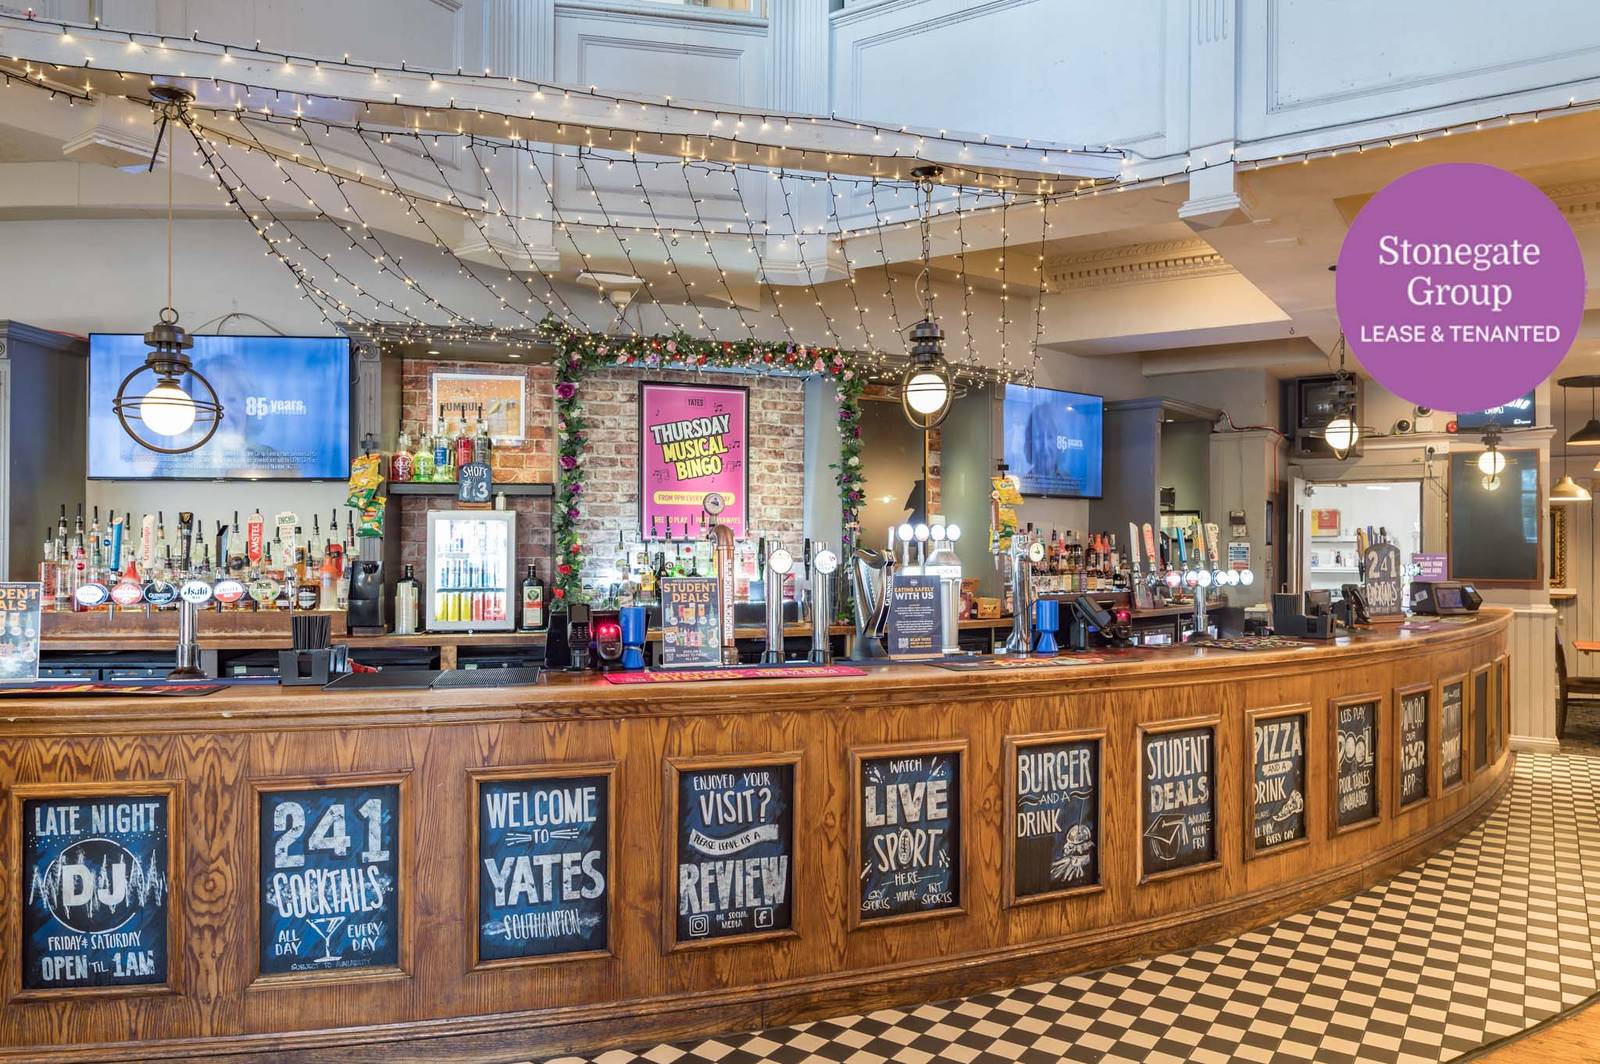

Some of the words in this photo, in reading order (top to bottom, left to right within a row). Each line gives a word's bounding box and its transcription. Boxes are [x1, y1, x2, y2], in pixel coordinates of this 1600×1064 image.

[650, 413, 730, 445] THURSDAY
[662, 433, 729, 463] MUSICAL
[463, 465, 488, 478] SHOTS
[674, 455, 723, 480] BINGO
[251, 522, 260, 553] AMSTEL
[0, 588, 39, 600] DENT
[183, 586, 208, 595] Asahi
[663, 583, 717, 593] STUDENT
[672, 592, 710, 602] DEALS
[895, 592, 920, 600] WITH
[921, 592, 934, 600] US
[0, 600, 27, 611] ALS
[1255, 721, 1302, 764] PIZZA
[1338, 727, 1374, 772] POOL
[890, 758, 923, 774] WATCH
[1147, 735, 1210, 780] STUDENT
[693, 774, 735, 791] ENJOYED
[743, 772, 770, 788] YOUR
[1018, 749, 1092, 795] BURGER
[486, 787, 597, 829] WELCOME
[700, 787, 771, 826] VISIT?
[865, 780, 949, 828] LIVE
[1040, 793, 1060, 804] AND
[1061, 791, 1070, 802] A
[1151, 776, 1210, 813] DEALS
[35, 806, 80, 836] LATE
[91, 803, 159, 834] NIGHT
[1017, 808, 1062, 837] DRINK
[534, 829, 550, 843] TO
[693, 834, 716, 850] PLEASE
[719, 841, 739, 850] LEAVE
[754, 831, 761, 840] A
[873, 828, 943, 872] SPORT
[62, 863, 126, 906] DJ
[272, 865, 383, 918] COCKTAILS
[484, 850, 605, 907] YATES
[679, 855, 788, 916] REVIEW
[895, 871, 919, 886] HERE
[921, 891, 952, 905] SPORTS
[279, 929, 300, 942] ALL
[348, 921, 383, 938] EVERY
[503, 909, 581, 940] SOUTHAMPTON
[48, 935, 82, 951] FRIDAY
[91, 930, 142, 949] SATURDAY
[275, 940, 301, 956] DAY
[352, 936, 379, 952] DAY
[42, 955, 88, 981] OPEN
[112, 950, 156, 977] 1AM
